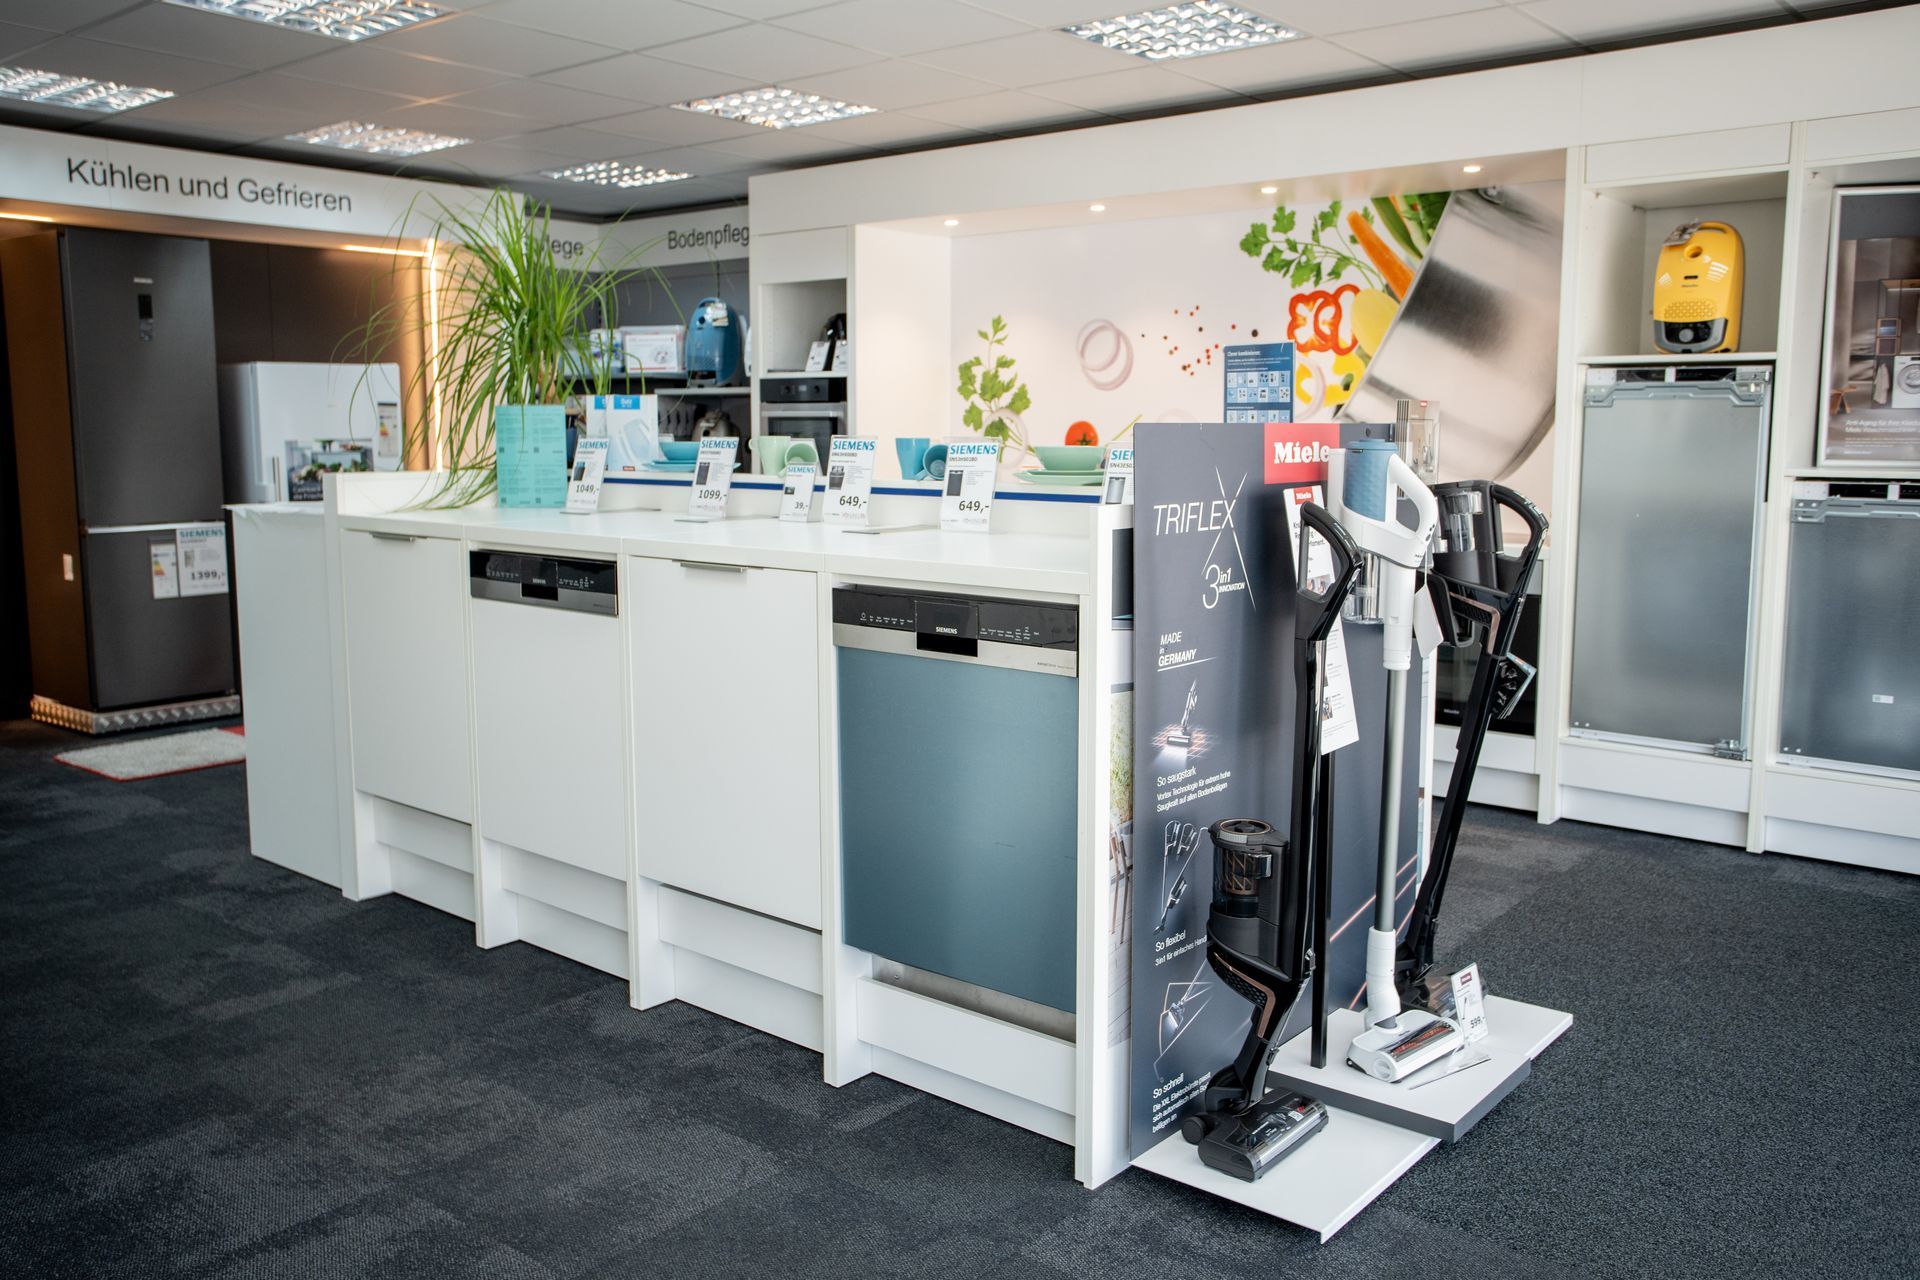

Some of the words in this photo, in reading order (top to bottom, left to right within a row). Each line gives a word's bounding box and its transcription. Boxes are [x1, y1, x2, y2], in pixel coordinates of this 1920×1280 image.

[67, 157, 169, 194] Kühlen
[179, 176, 229, 200] und
[238, 178, 352, 213] Gefrieren
[579, 440, 608, 450] SIEMENS
[701, 439, 737, 450] SIEMENS
[832, 440, 876, 451] SIEMENS
[949, 444, 998, 456] SIEMENS
[1273, 441, 1330, 465] Miele
[787, 466, 816, 474] SIEMENS
[576, 483, 600, 495] 1049,-
[698, 489, 728, 502] 1099,-
[794, 501, 809, 512] 39,-
[839, 495, 867, 509] 649,-
[958, 500, 990, 514] 649,-
[1153, 498, 1238, 537] TRIFLEX
[180, 528, 225, 539] SIEMENS
[935, 626, 958, 635] SIEMENS
[1160, 631, 1183, 646] MADE
[1159, 646, 1165, 655] in
[1158, 648, 1198, 667] GERMANY
[1157, 776, 1167, 787] So
[1167, 766, 1197, 784] saugstark
[1156, 790, 1172, 801] Vortex
[1155, 941, 1165, 952] So
[1165, 929, 1186, 948] flexibel
[1152, 1088, 1163, 1099] So
[1162, 1072, 1184, 1093] schnell
